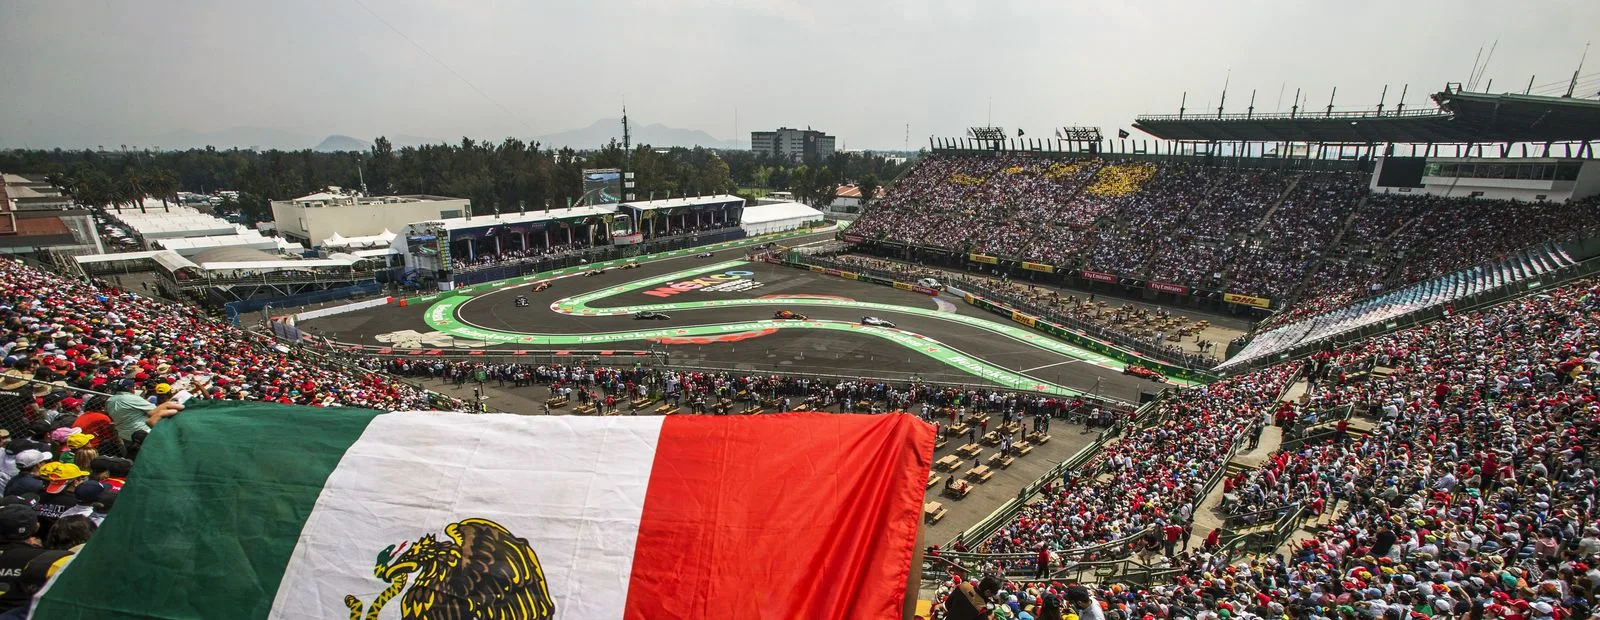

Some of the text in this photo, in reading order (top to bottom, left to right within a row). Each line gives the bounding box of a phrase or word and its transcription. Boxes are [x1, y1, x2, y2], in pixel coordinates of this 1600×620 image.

[1231, 295, 1259, 304] DHL
[1015, 313, 1031, 325] DHL
[720, 321, 808, 332] Heineken
[577, 330, 670, 343] Heineken
[949, 356, 1025, 386] Heineken
